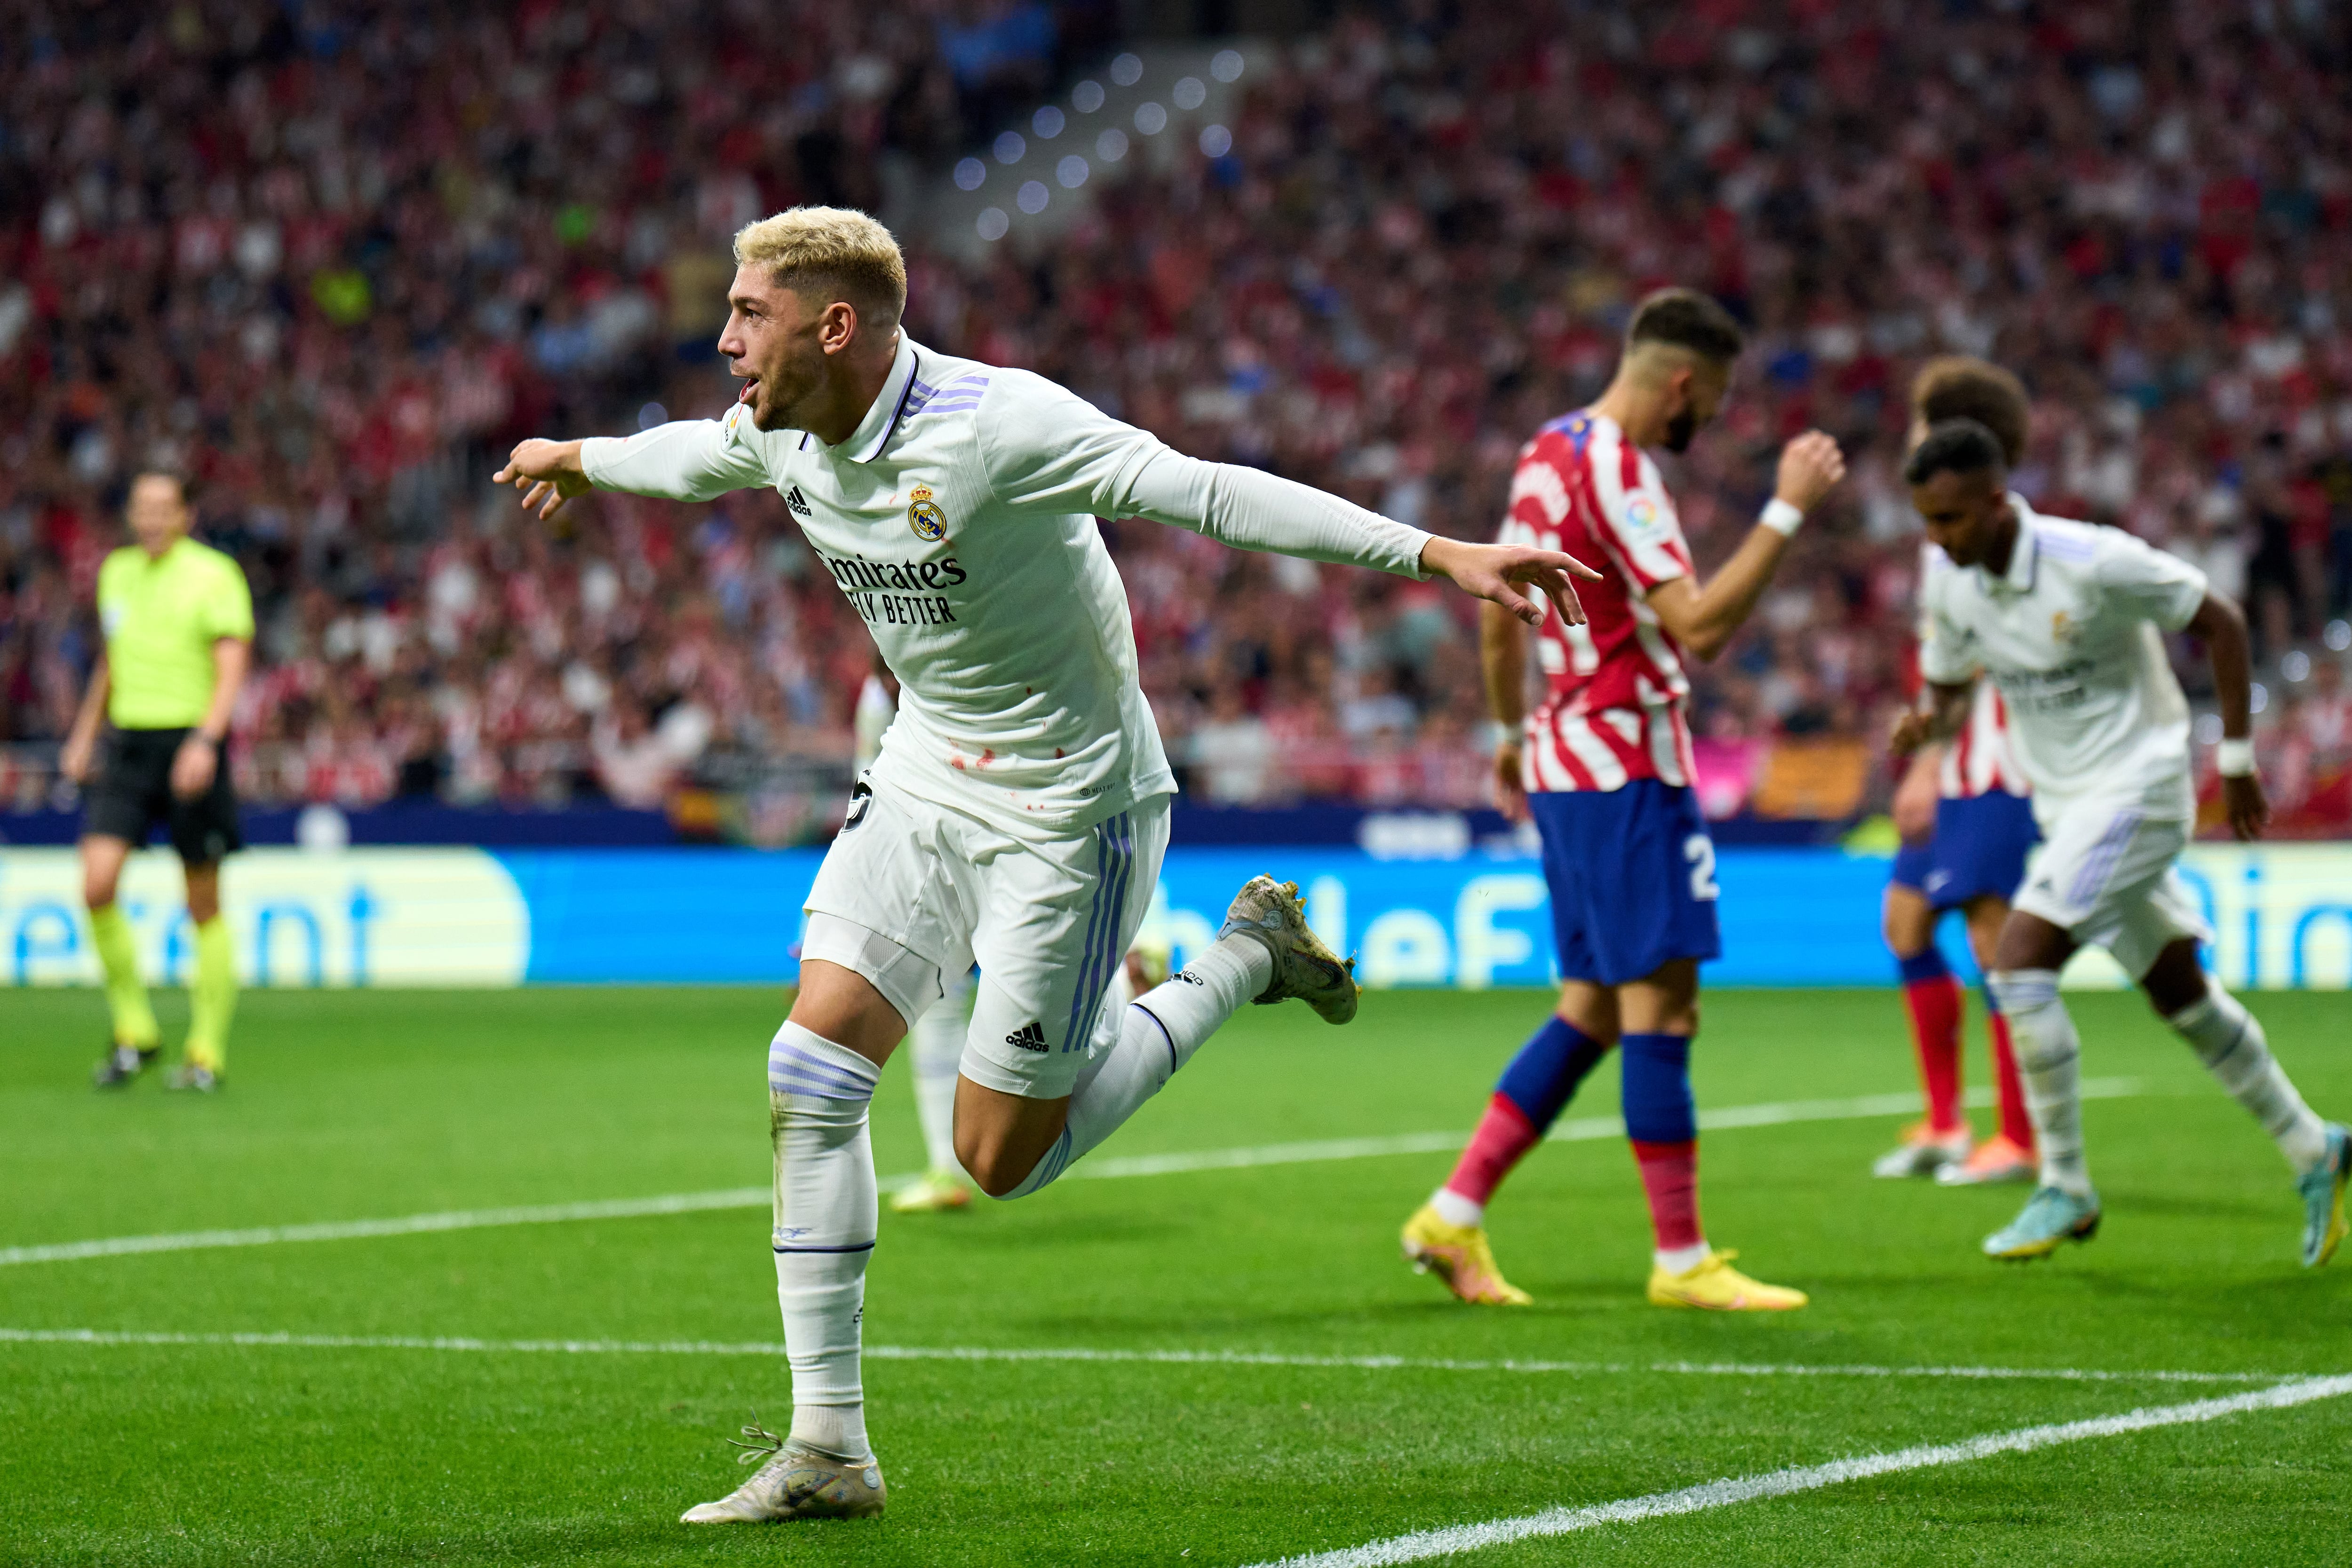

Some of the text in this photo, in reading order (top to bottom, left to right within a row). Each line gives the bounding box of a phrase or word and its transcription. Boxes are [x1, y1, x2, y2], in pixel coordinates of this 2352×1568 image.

[787, 501, 812, 516] adidas
[847, 591, 957, 625] FLY BETTER
[1005, 1035, 1050, 1053] adidas
